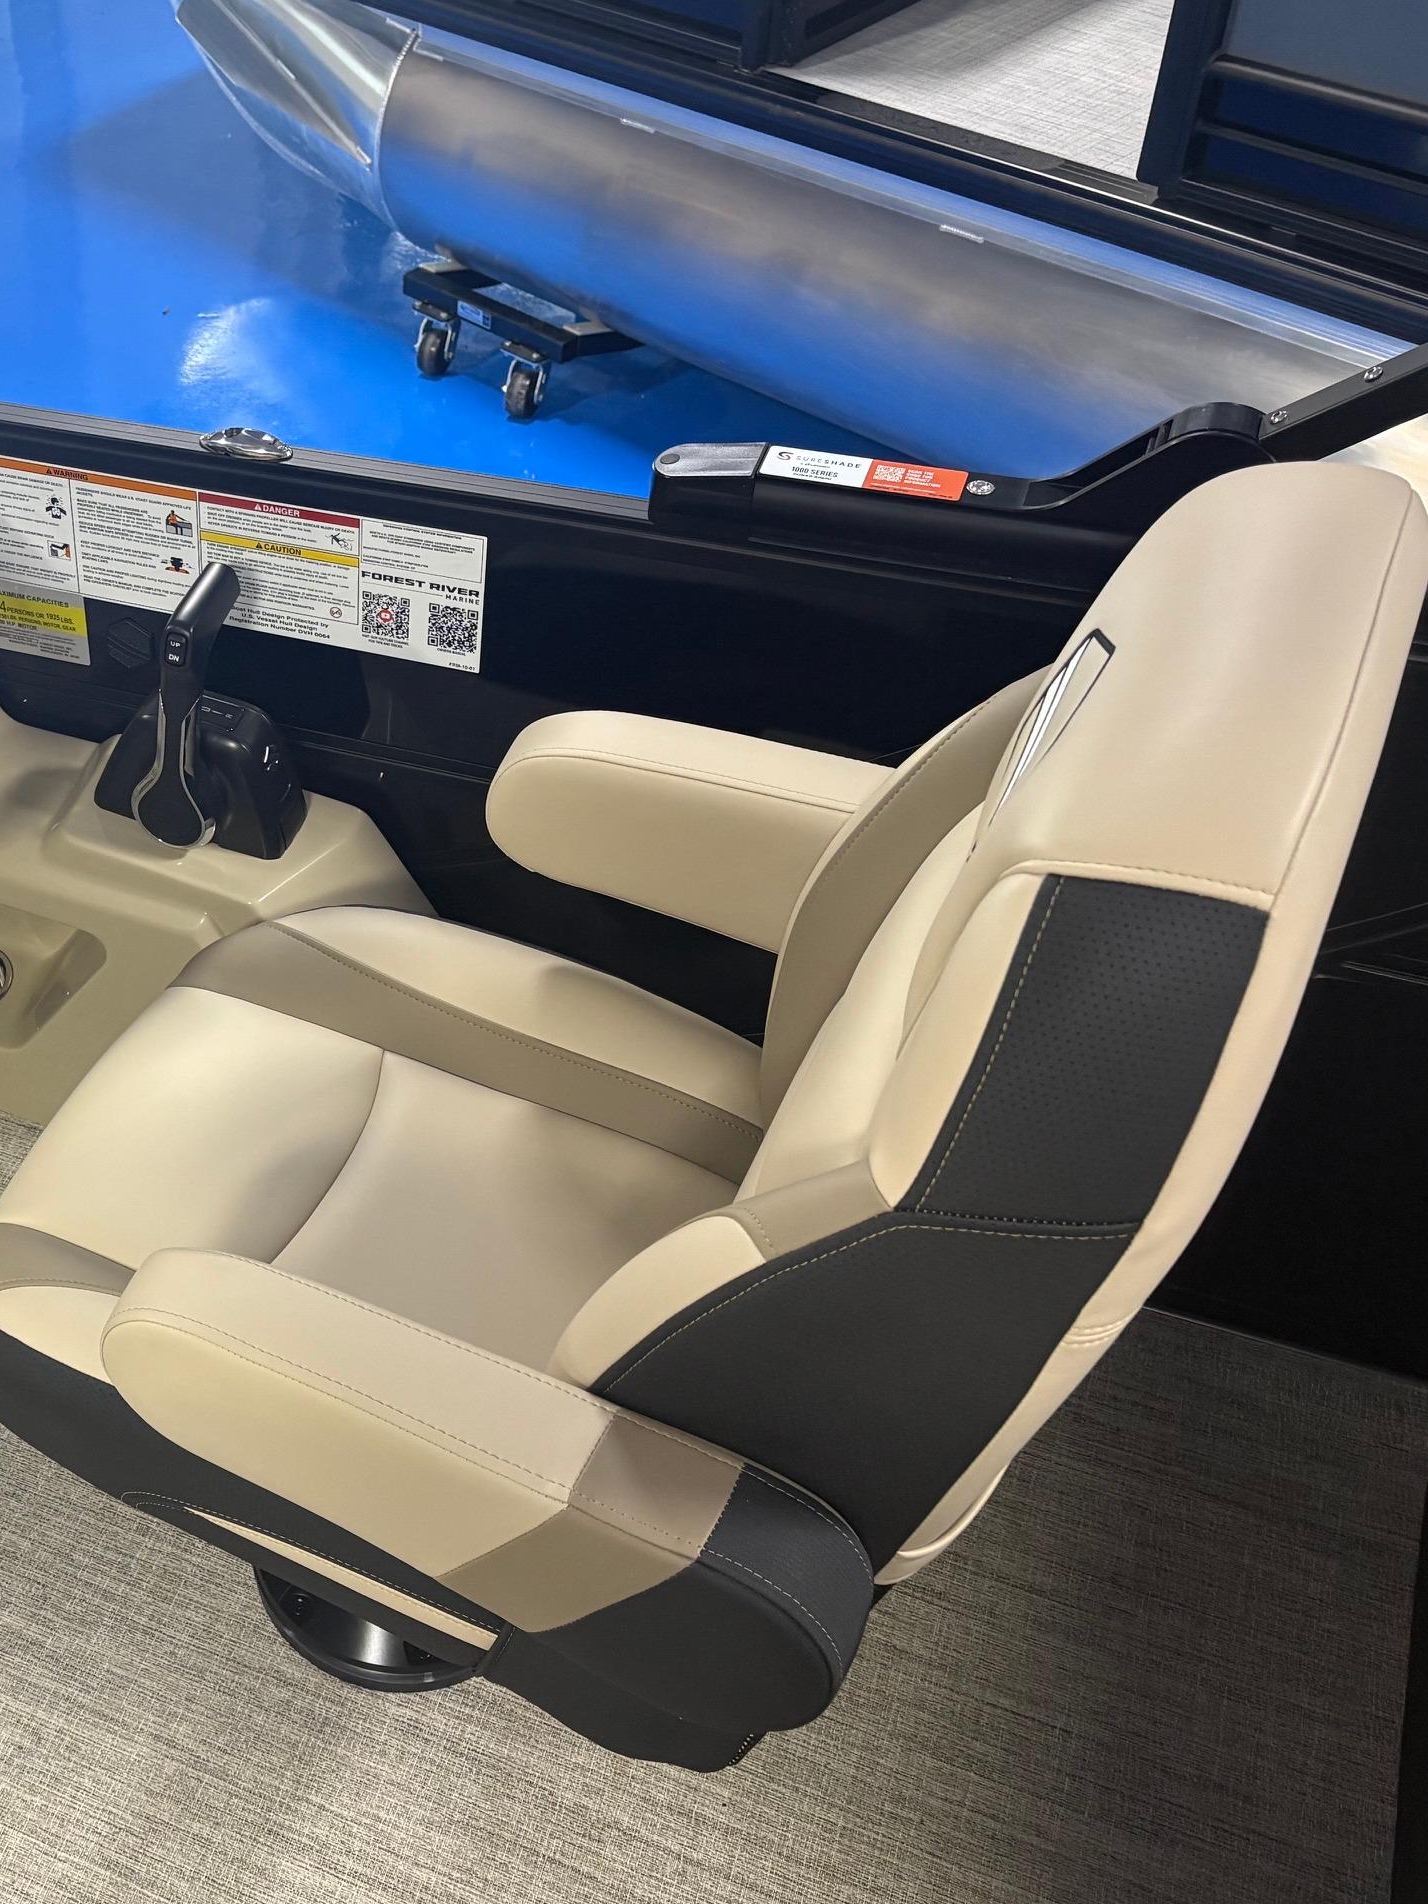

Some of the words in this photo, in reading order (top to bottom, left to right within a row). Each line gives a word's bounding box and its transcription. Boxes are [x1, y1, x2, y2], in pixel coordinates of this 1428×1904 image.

[53, 468, 89, 481] WARNING
[811, 468, 839, 478] SERIES
[262, 504, 300, 517] DANGER
[264, 543, 302, 556] CAUTION
[361, 571, 426, 588] FOREST
[429, 582, 480, 598] RIVER
[26, 595, 70, 608] CAPACITIES
[445, 594, 480, 606] MARINE
[6, 607, 35, 617] PERSONS
[262, 610, 286, 620] Design
[287, 616, 319, 627] Protected
[229, 616, 269, 629] Registration
[270, 623, 297, 634] Number
[256, 615, 278, 625] Vessel
[279, 619, 293, 627] Hull
[294, 622, 318, 632] Design
[170, 640, 181, 649] UP
[168, 653, 180, 663] DN
